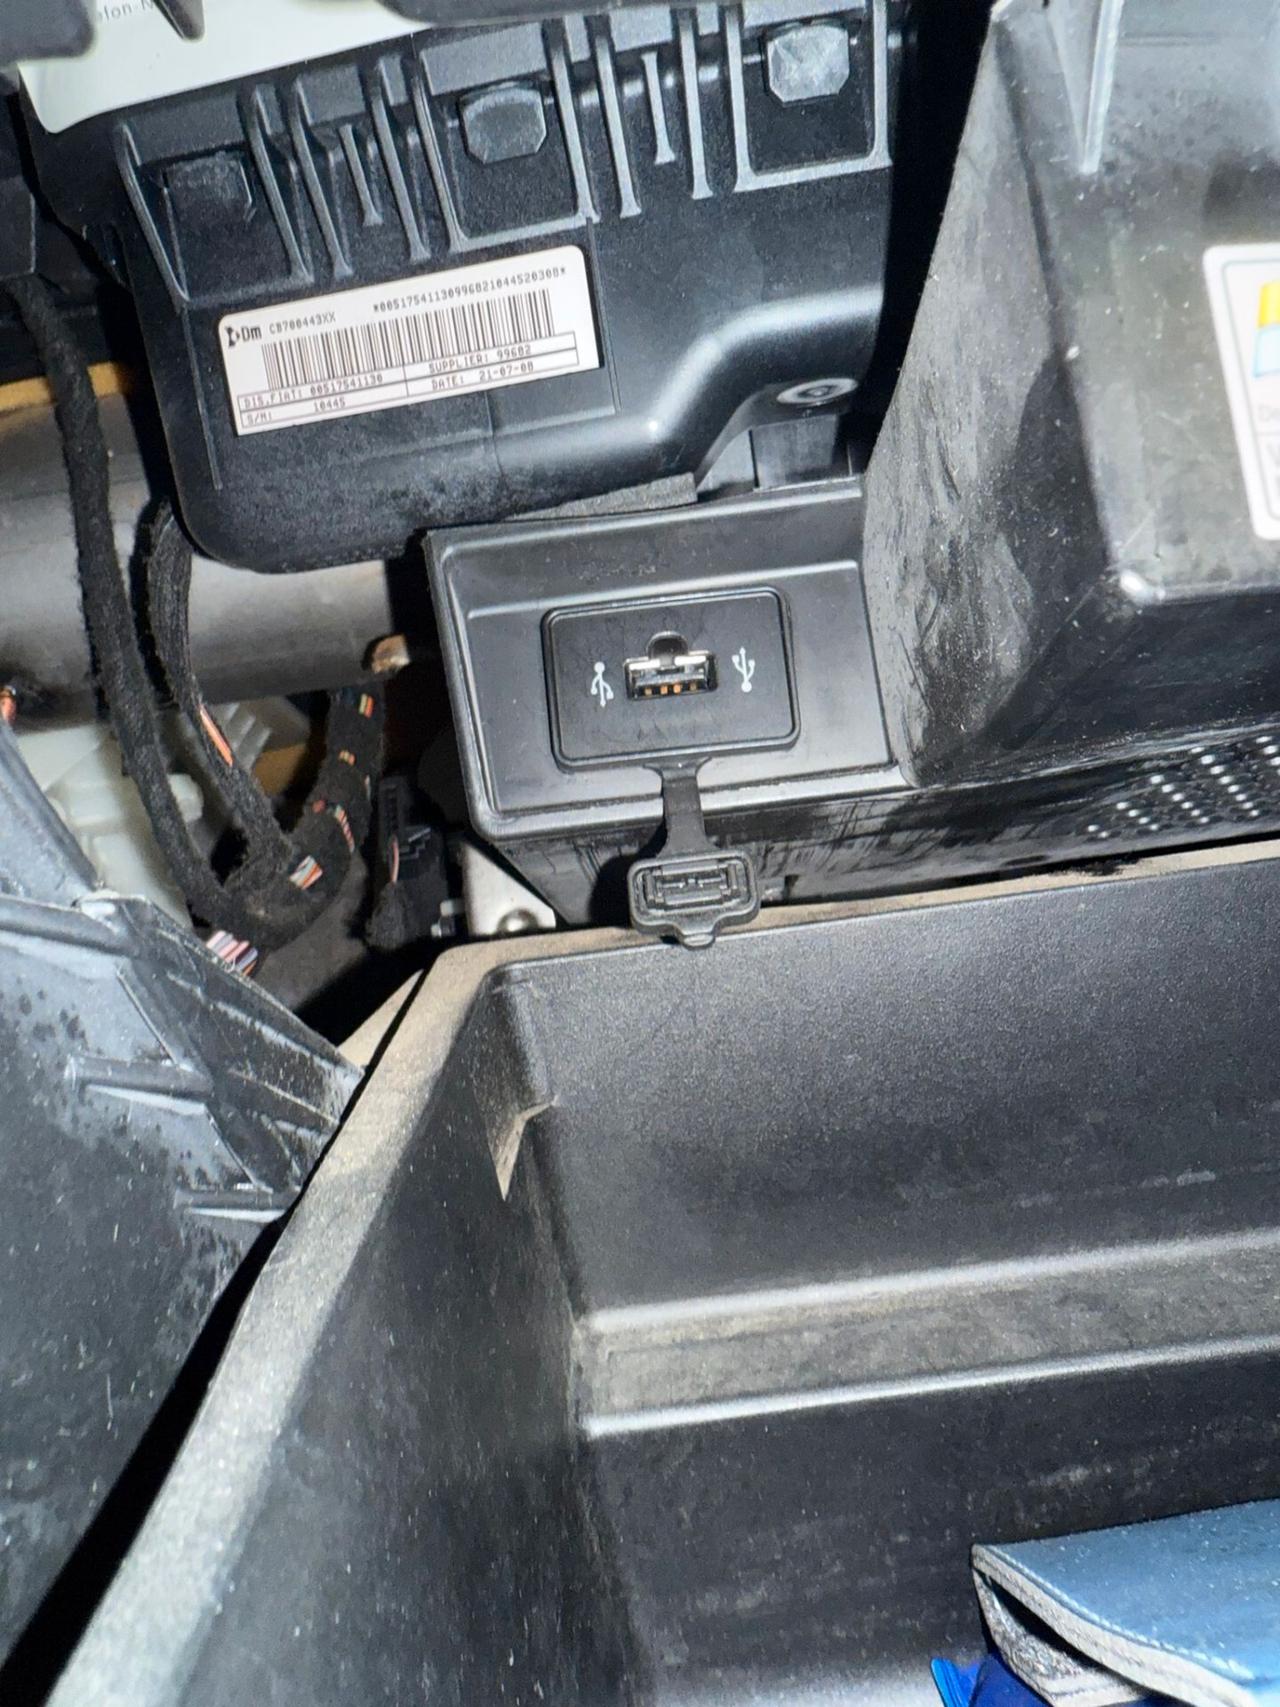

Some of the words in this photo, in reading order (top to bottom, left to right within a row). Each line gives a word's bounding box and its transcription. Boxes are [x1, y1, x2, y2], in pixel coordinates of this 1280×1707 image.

[427, 351, 489, 374] SUPPLIER:
[309, 371, 383, 397] 00517541130
[430, 373, 464, 391] DATE:
[312, 396, 346, 413] 10445
